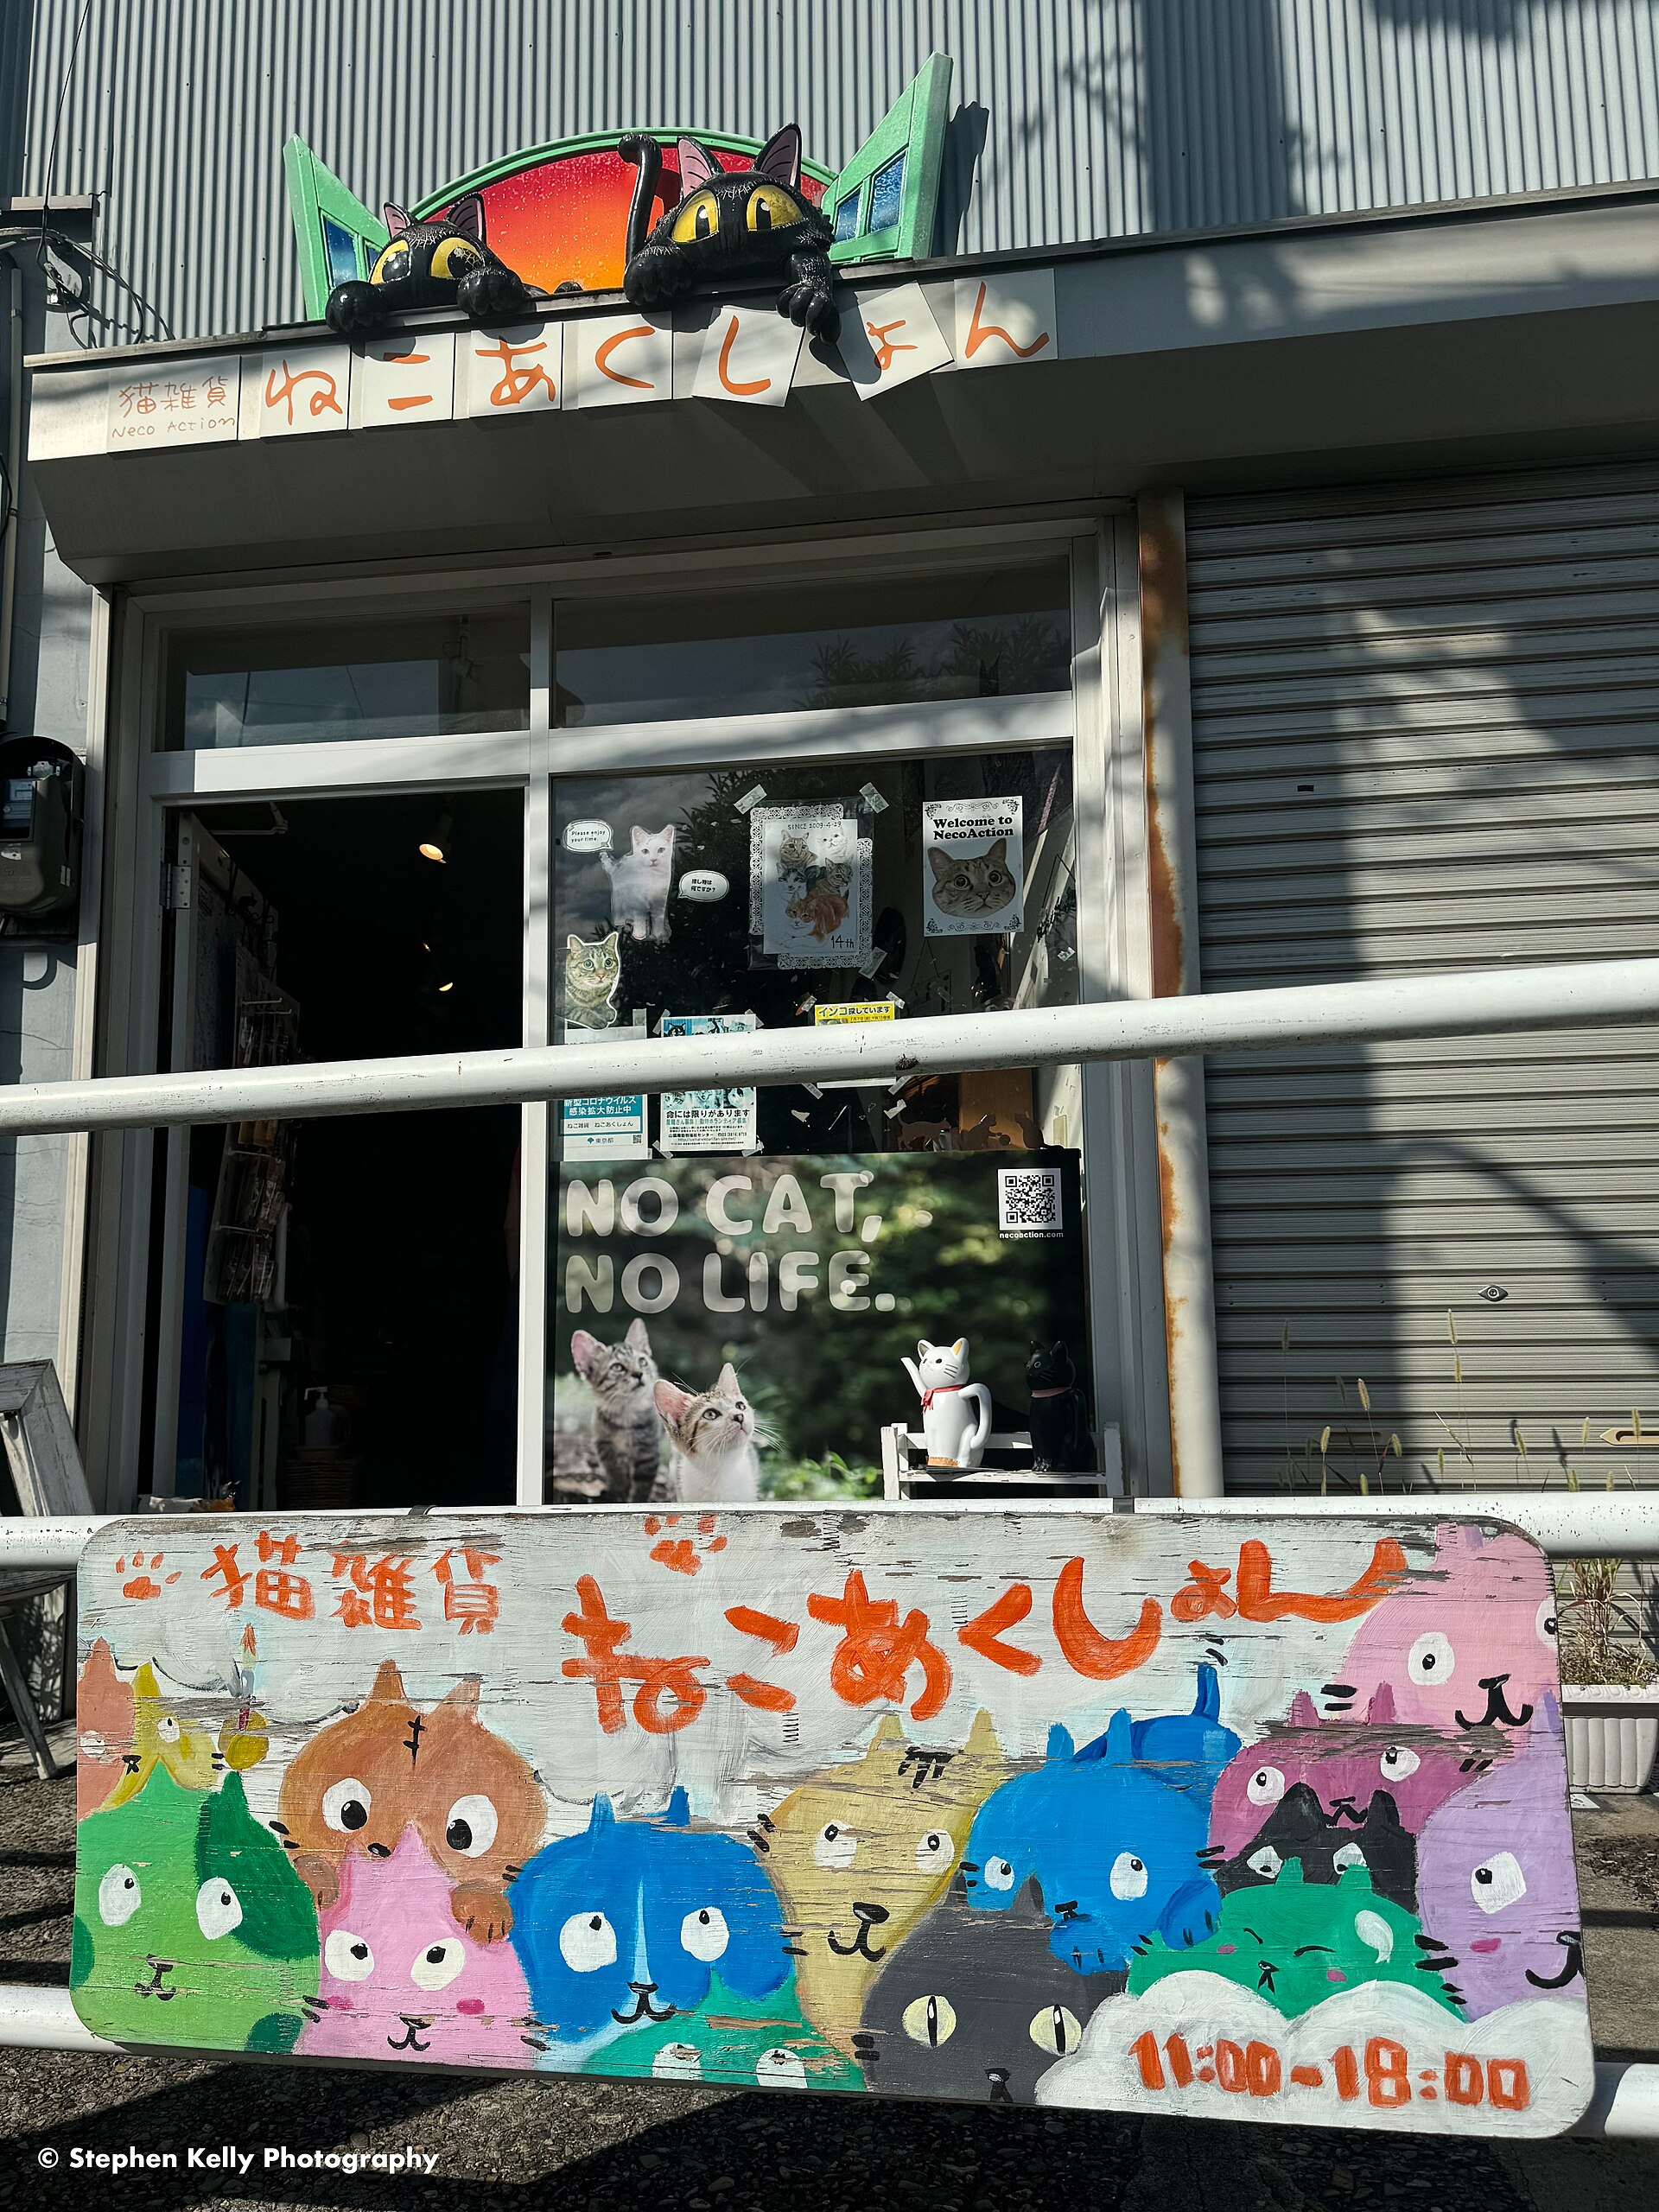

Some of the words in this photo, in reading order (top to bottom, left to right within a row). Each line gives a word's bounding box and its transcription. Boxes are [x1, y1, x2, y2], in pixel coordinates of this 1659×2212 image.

[118, 375, 229, 418] 猫雑貨
[111, 426, 156, 438] Neco
[933, 817, 995, 830] Welcome
[998, 816, 1013, 825] to
[933, 827, 1014, 841] NecoAction
[830, 935, 855, 949] 14th
[818, 1006, 890, 1017] インコ探しています
[564, 1096, 637, 1106] 新型コロナウイルス
[569, 1105, 632, 1116] 感染拡大防止中
[666, 1109, 750, 1118] 命には限りがあります
[565, 1176, 680, 1237] NO
[705, 1172, 883, 1243] CAT,
[999, 1230, 1064, 1239] necoaction.com
[565, 1252, 680, 1313] NO
[702, 1250, 896, 1313] LIFE.
[200, 1530, 503, 1636] 猫雑貨
[1128, 2030, 1531, 2112] 11:00-18:00
